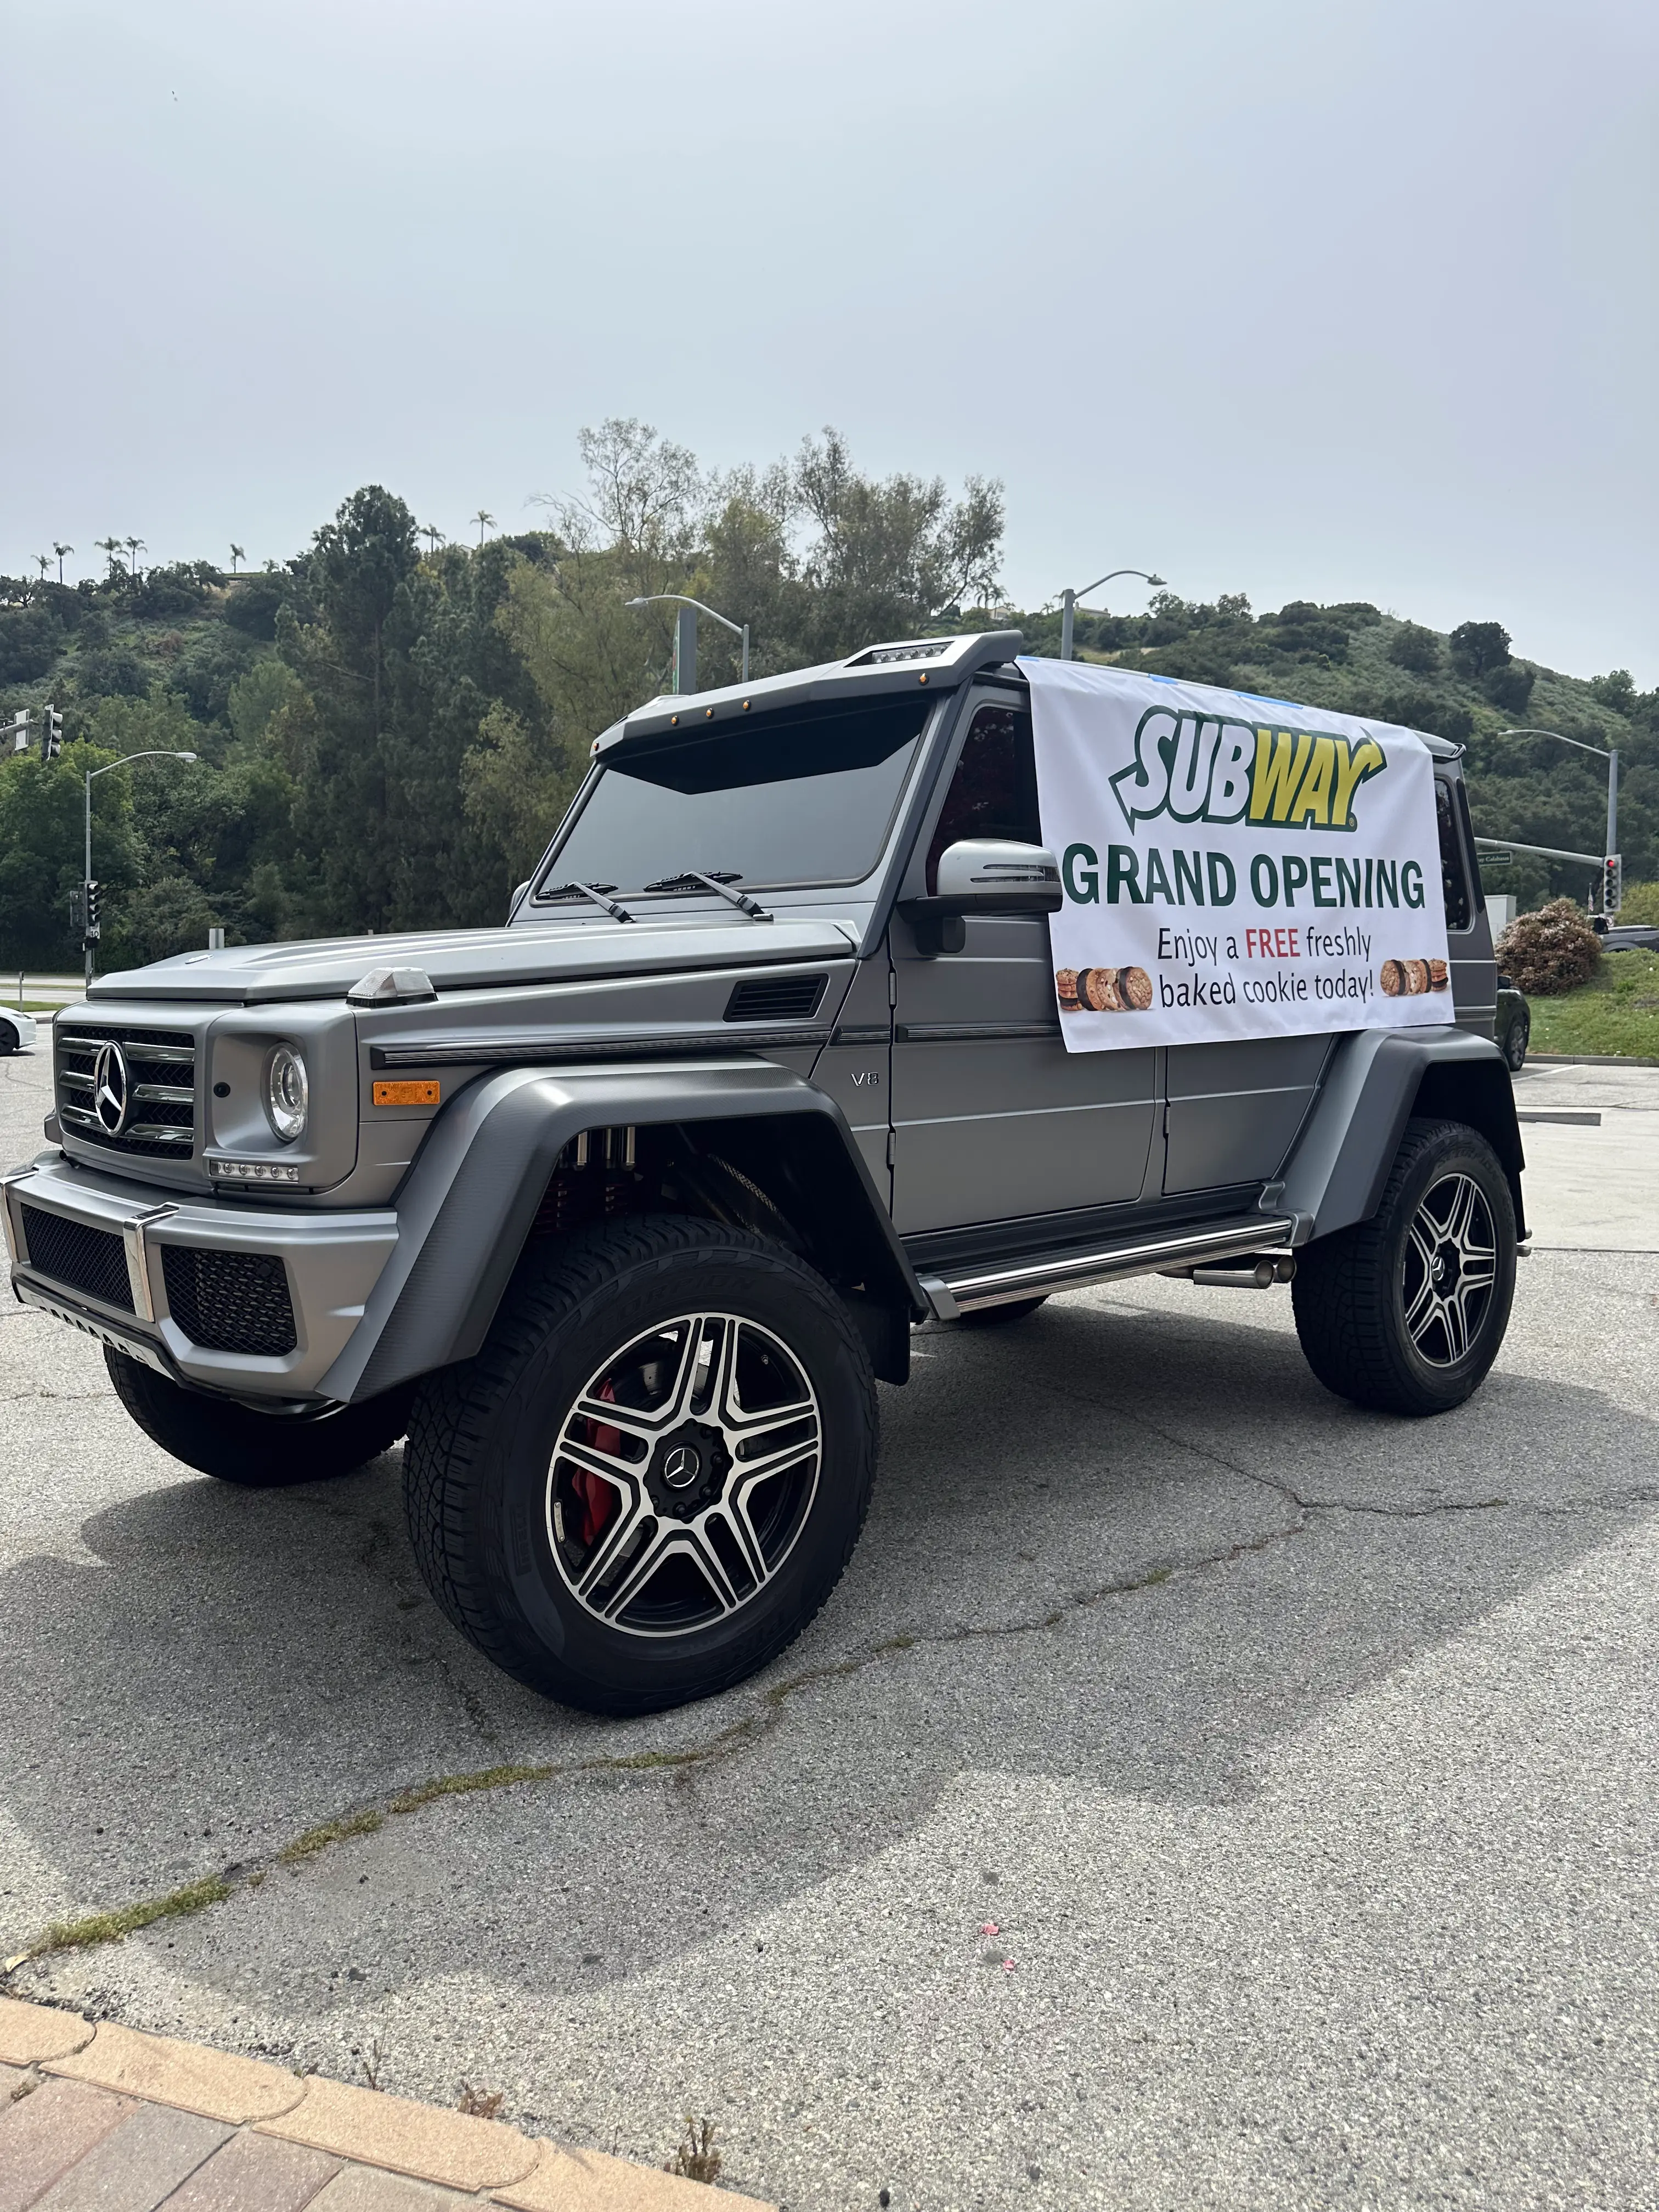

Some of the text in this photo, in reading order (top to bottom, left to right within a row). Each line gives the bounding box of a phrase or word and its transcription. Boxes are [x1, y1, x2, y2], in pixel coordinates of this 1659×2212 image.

[1108, 705, 1387, 836] SUBWAY
[1062, 843, 1425, 909] GRAND OPENING
[1158, 927, 1371, 967] Enjoy a FREE freshly
[1159, 969, 1373, 1008] baked cookie today!
[851, 1071, 879, 1087] V8
